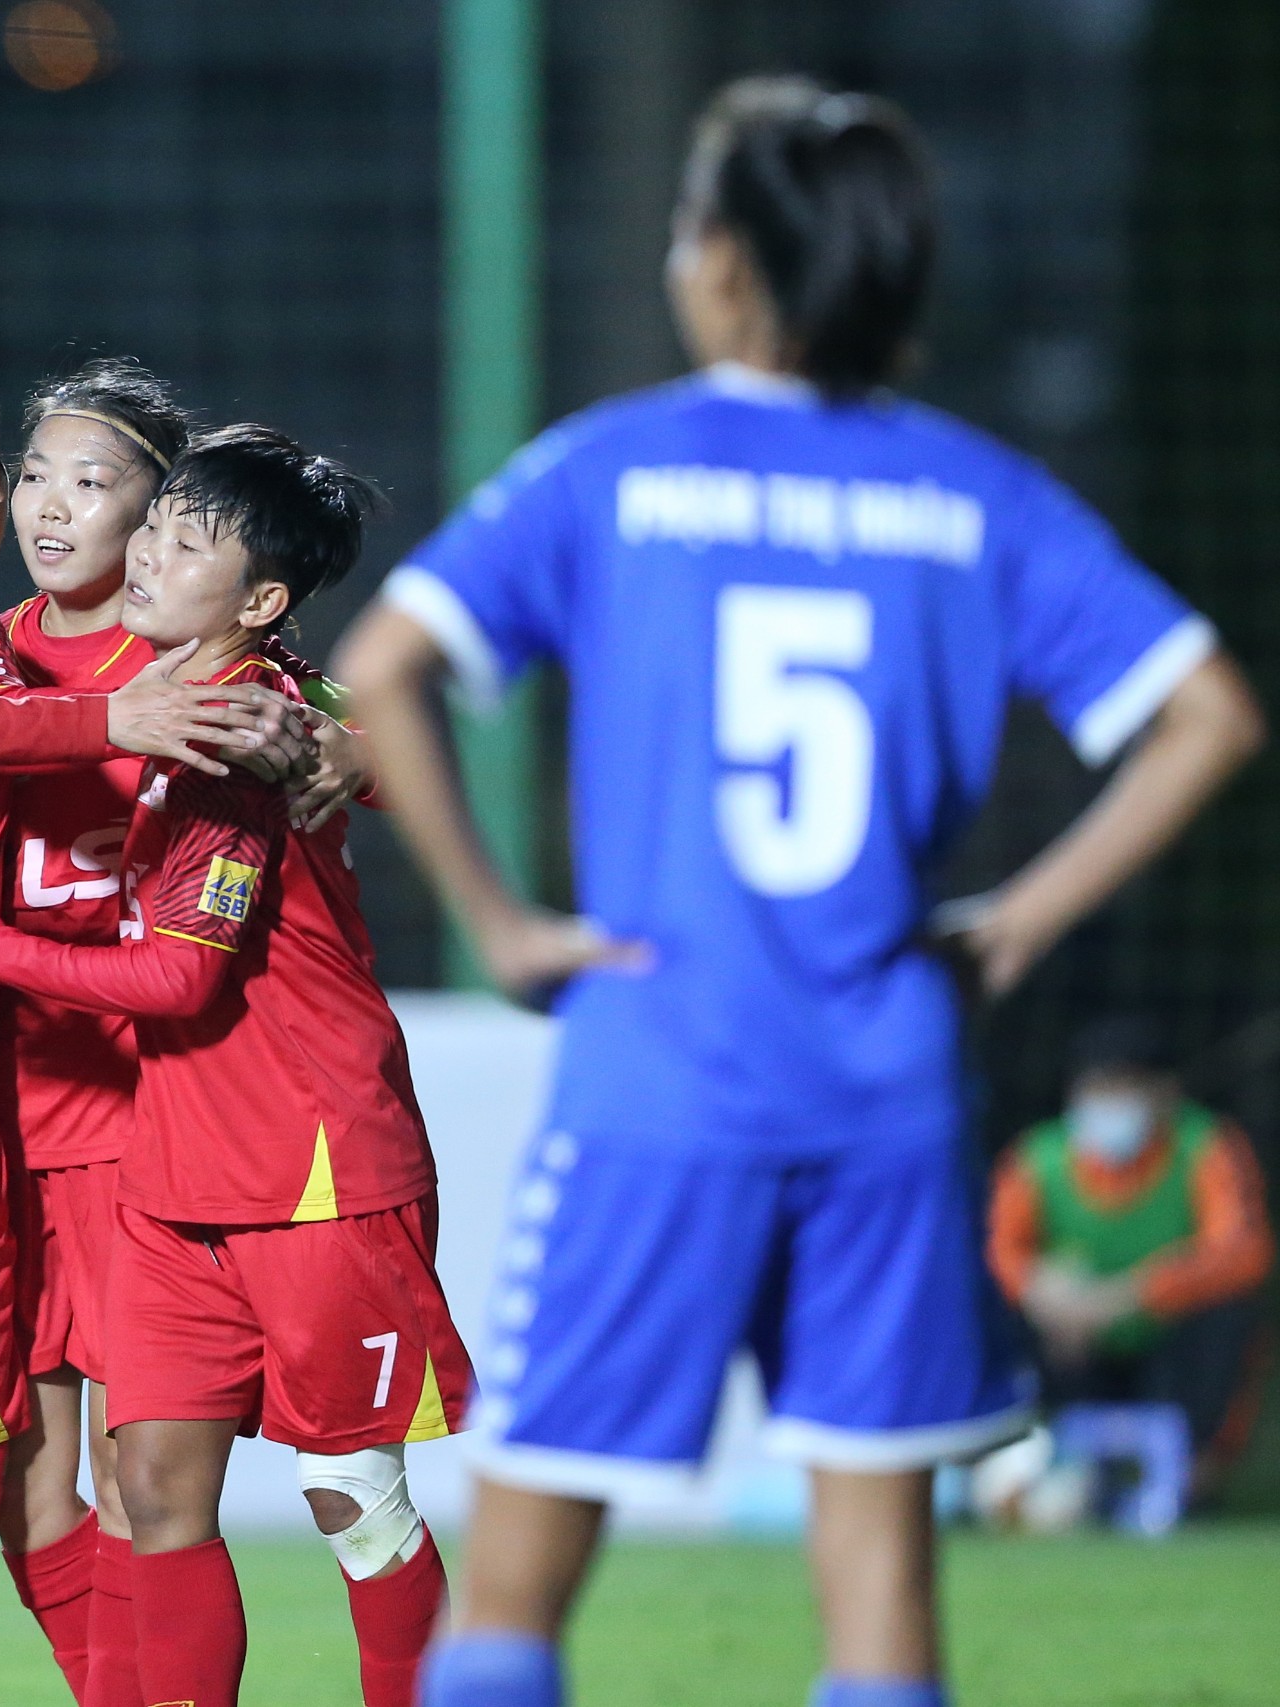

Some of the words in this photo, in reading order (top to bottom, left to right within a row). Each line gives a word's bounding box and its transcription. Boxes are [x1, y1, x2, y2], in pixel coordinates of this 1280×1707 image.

[714, 582, 874, 898] 5
[205, 889, 246, 919] TSB
[361, 1331, 398, 1408] 7
